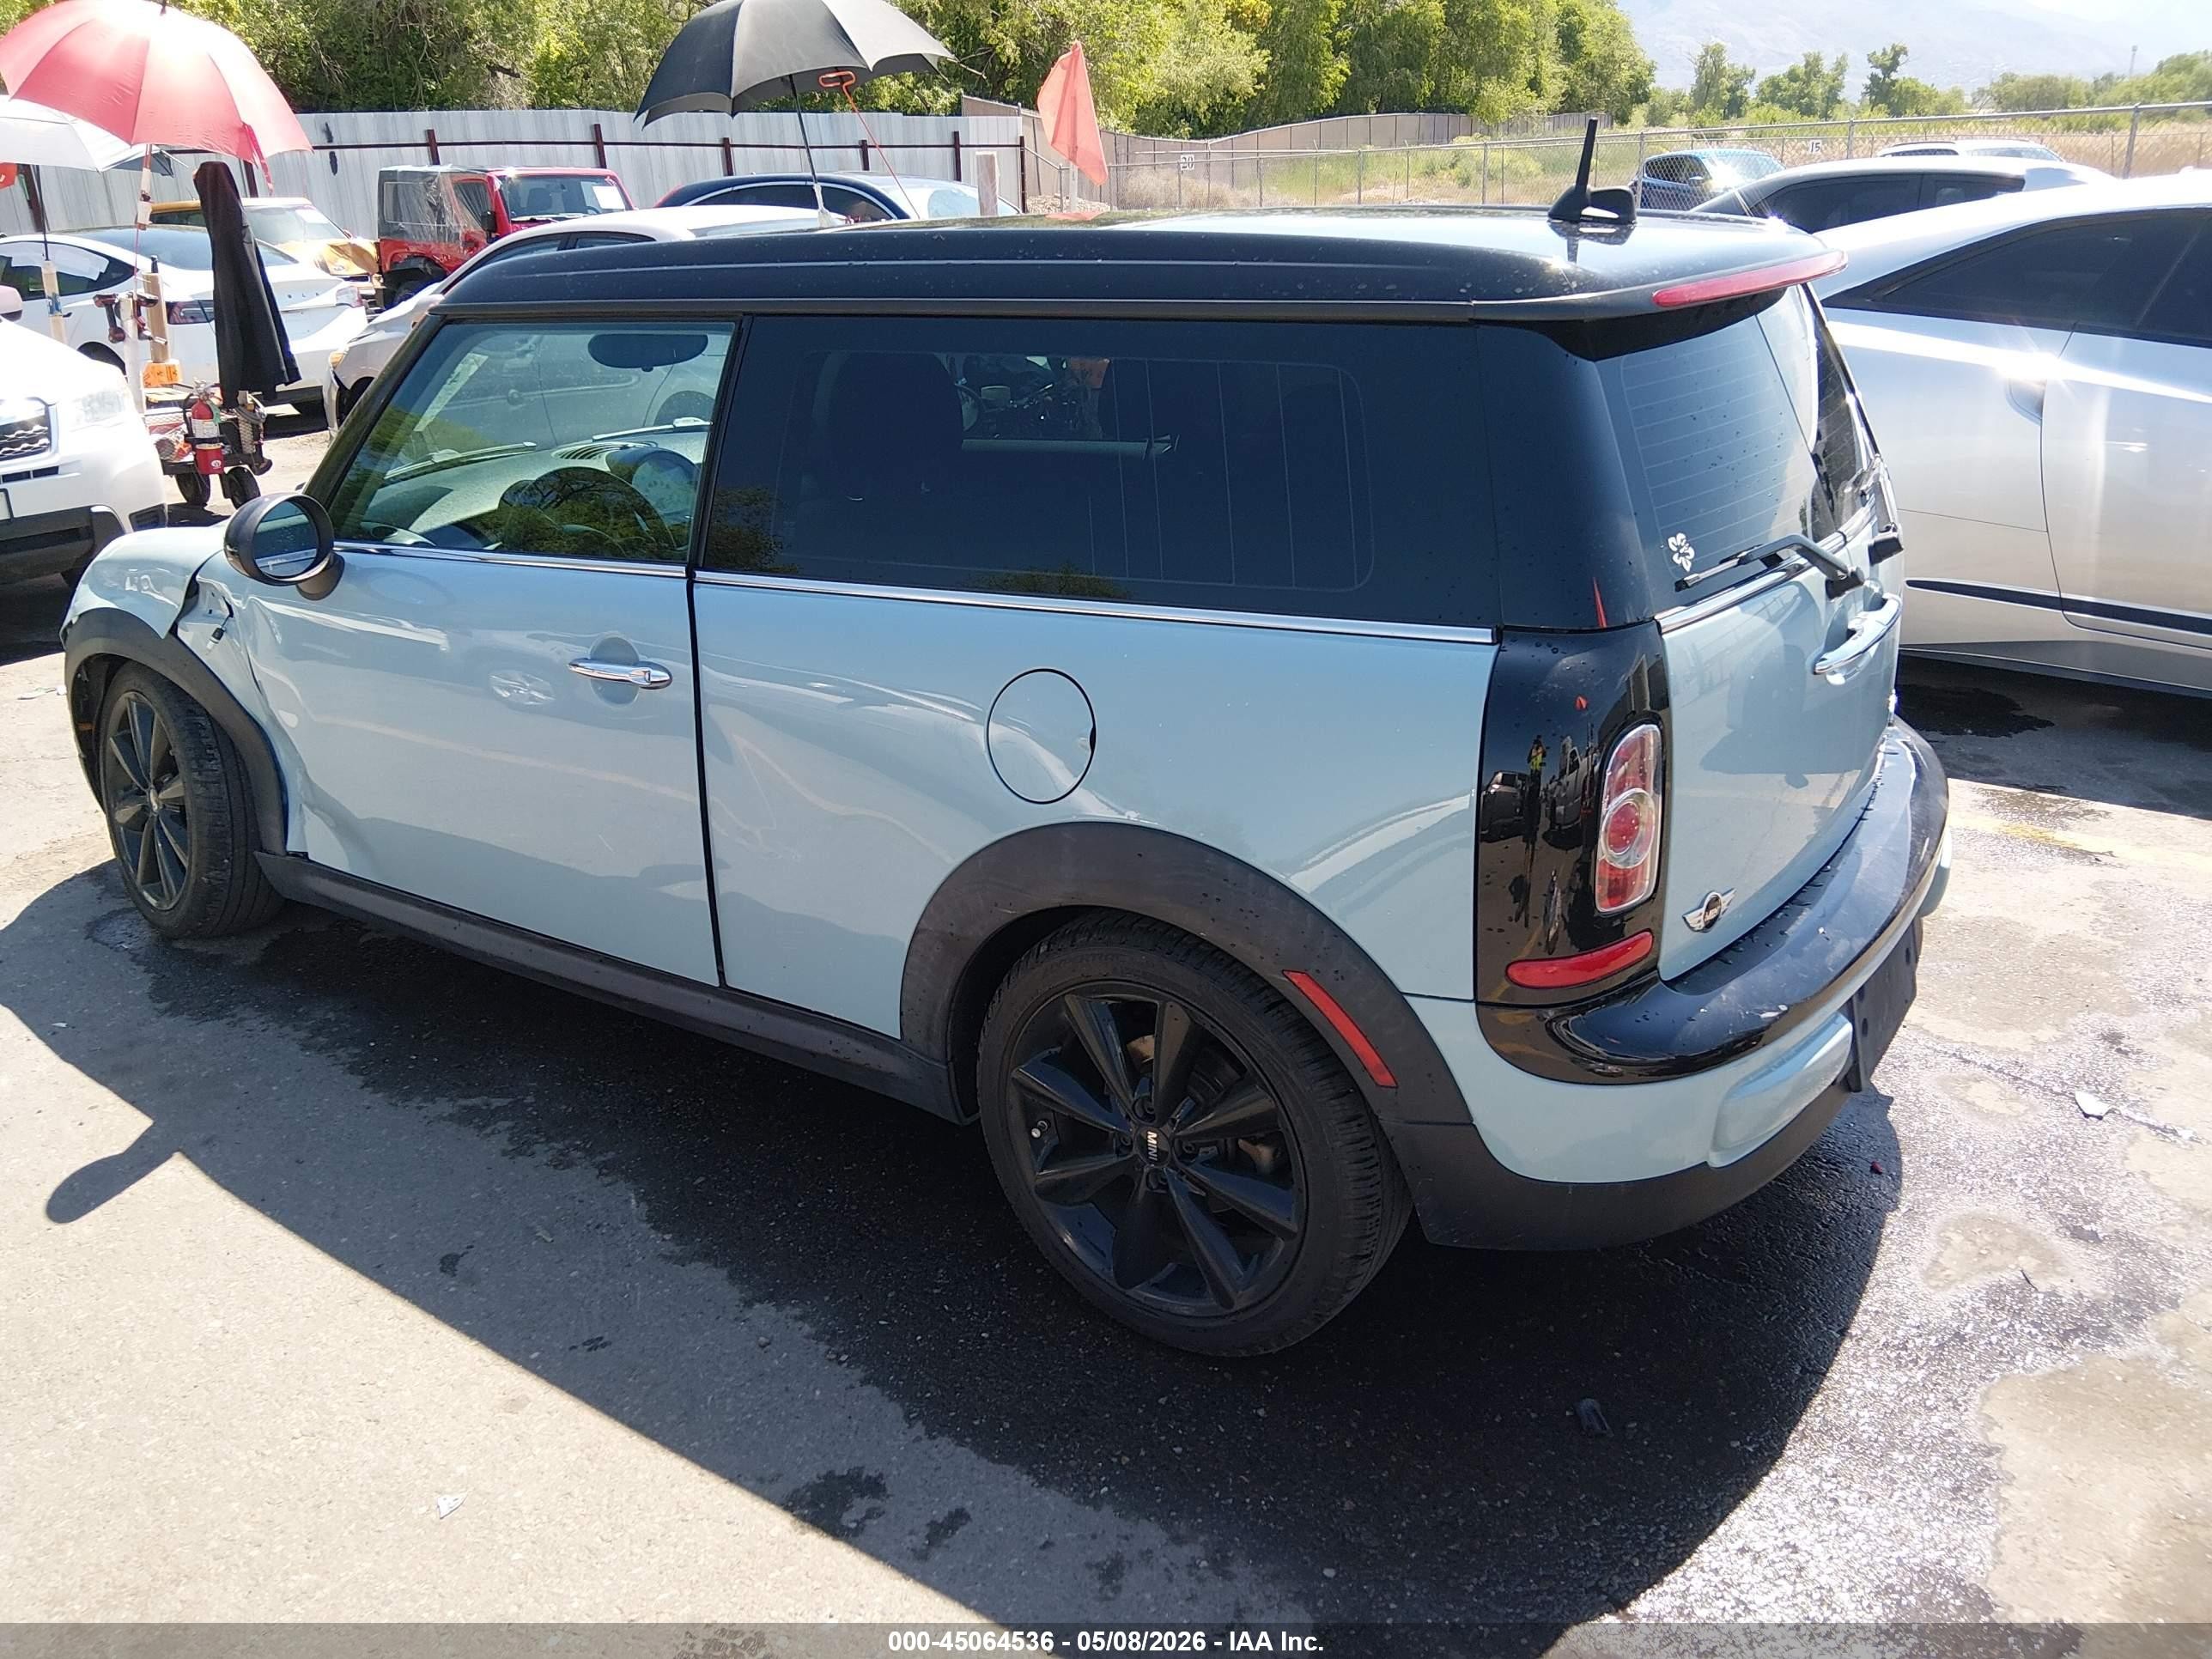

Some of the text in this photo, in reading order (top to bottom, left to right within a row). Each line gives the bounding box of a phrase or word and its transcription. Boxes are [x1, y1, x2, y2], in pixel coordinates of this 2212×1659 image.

[1811, 142, 1820, 153] 15
[1182, 156, 1194, 169] 20
[1146, 1131, 1158, 1161] MINI
